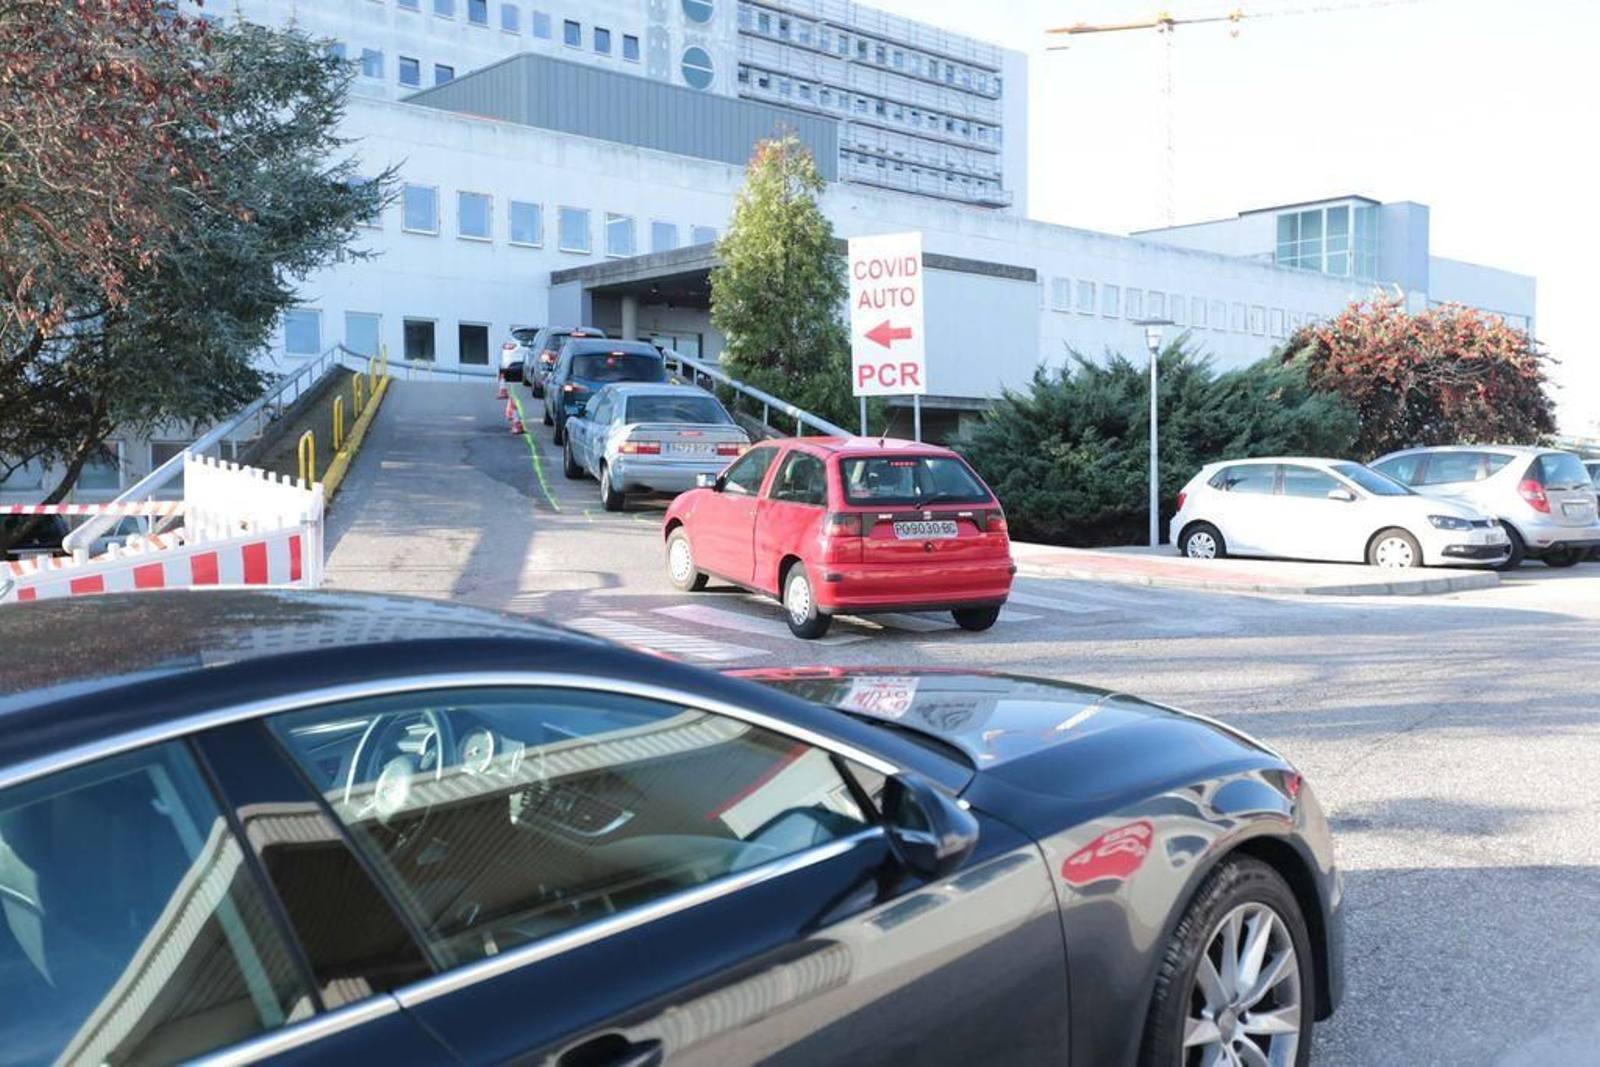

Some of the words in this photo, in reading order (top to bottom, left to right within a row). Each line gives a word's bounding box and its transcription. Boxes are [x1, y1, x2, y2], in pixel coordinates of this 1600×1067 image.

[854, 257, 917, 280] COVID
[858, 287, 915, 309] AUTO
[858, 362, 920, 388] PCR
